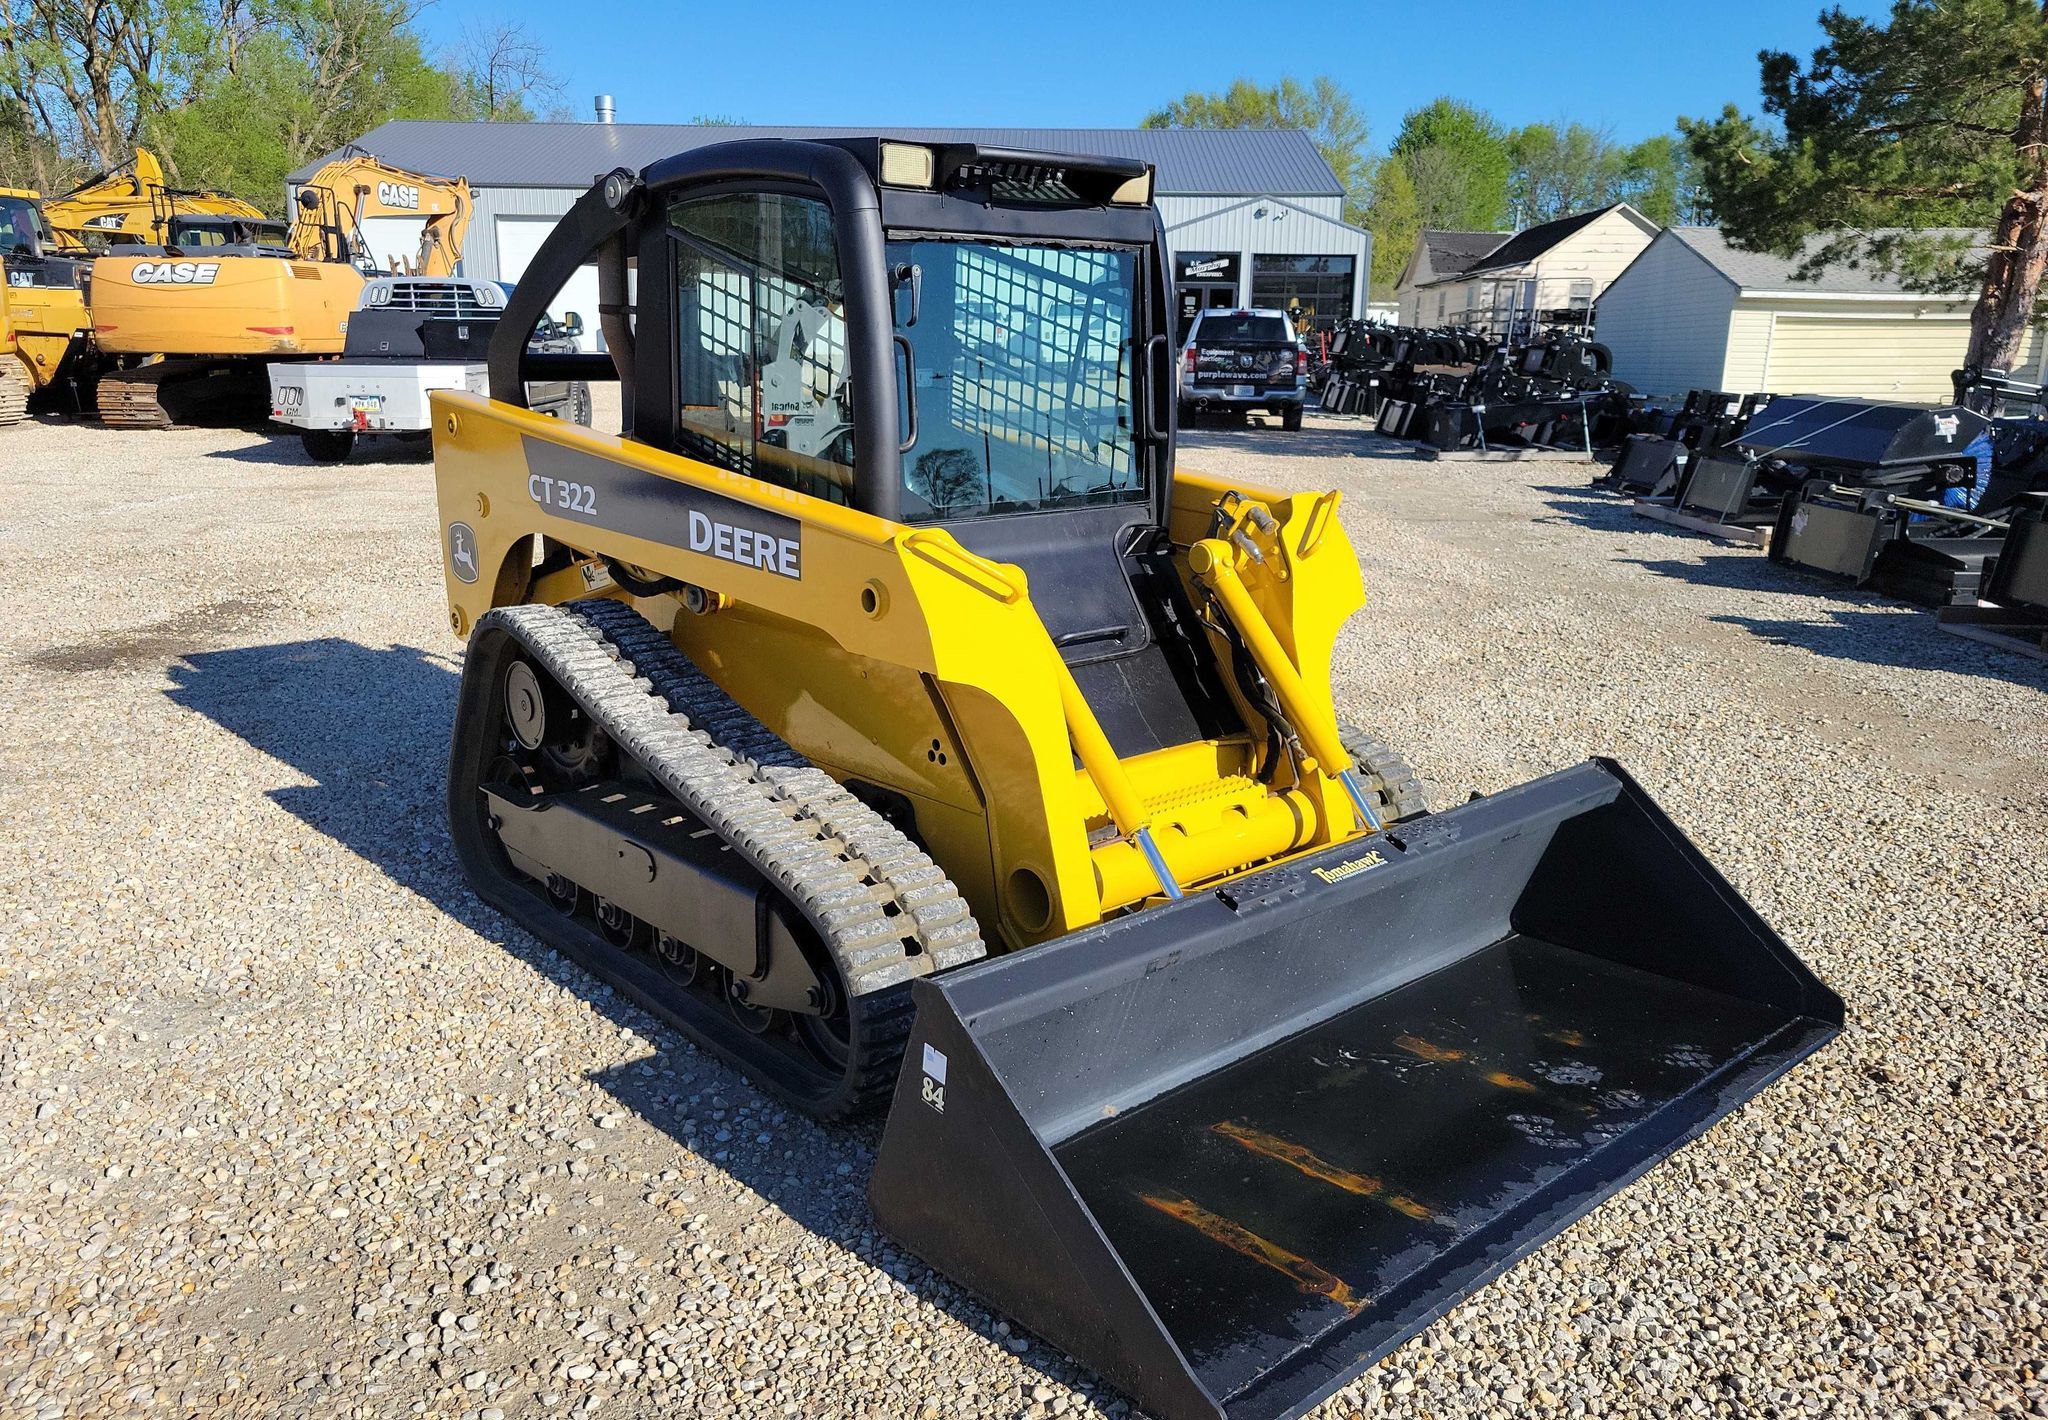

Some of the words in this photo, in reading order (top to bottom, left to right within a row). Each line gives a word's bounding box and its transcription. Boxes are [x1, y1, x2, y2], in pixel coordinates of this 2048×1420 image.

[378, 181, 419, 210] CASE
[100, 216, 118, 229] CAT
[10, 271, 34, 287] CAT
[132, 262, 221, 284] CASE
[1198, 371, 1268, 379] purplewave.com
[528, 474, 554, 504] CT
[558, 480, 598, 516] 322
[689, 510, 800, 578] DEERE
[922, 1076, 945, 1111] 84
